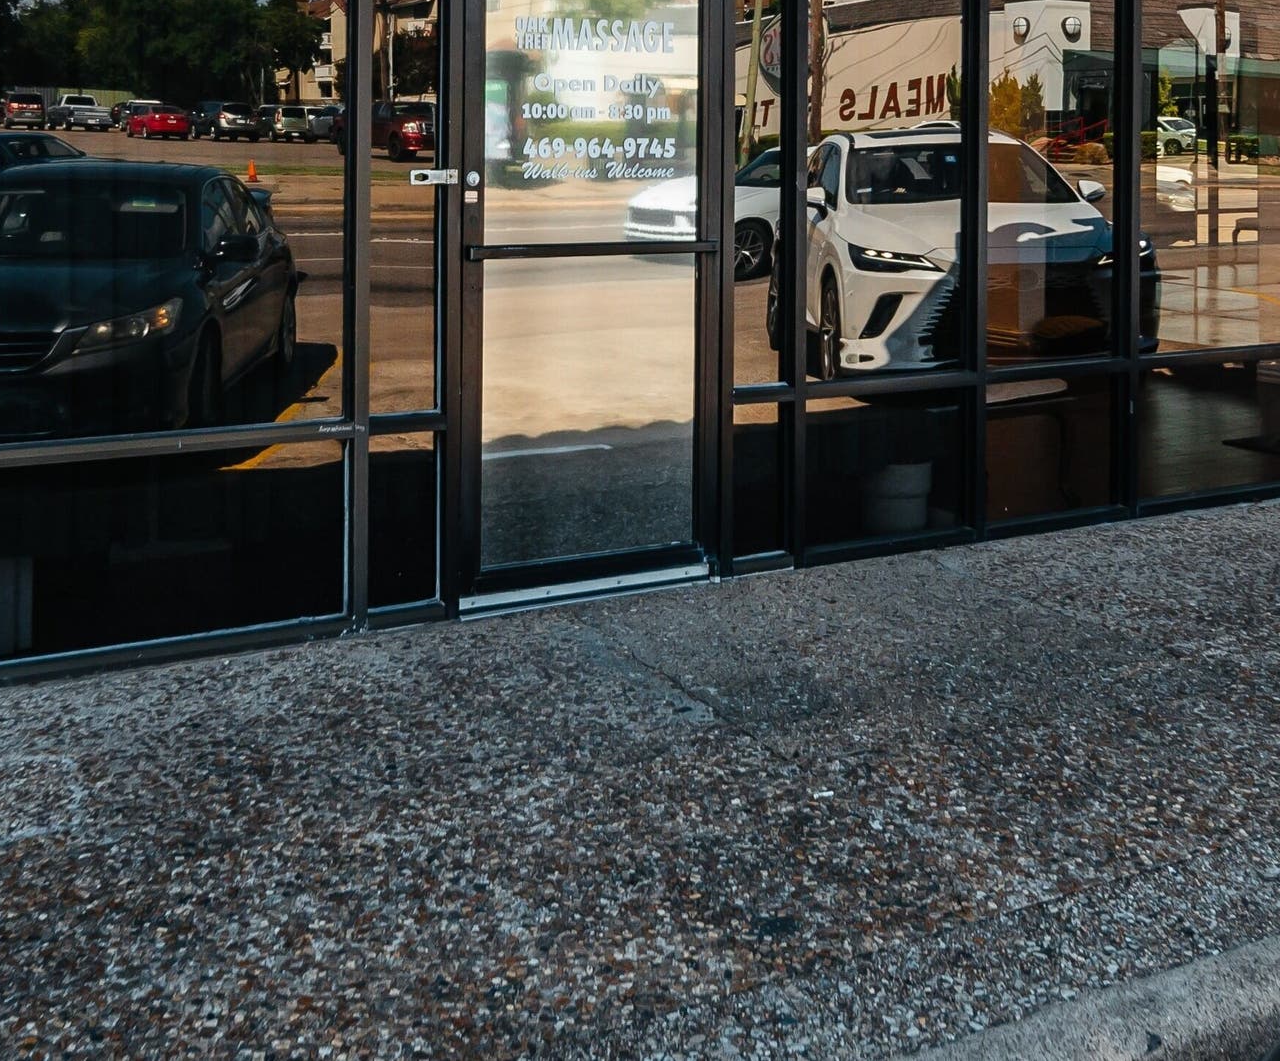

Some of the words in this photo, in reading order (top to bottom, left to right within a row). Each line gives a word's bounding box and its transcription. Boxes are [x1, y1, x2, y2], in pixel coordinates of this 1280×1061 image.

[515, 17, 548, 33] OAK
[551, 17, 674, 53] MASSAGE
[534, 73, 596, 97] Open
[604, 74, 660, 98] Daily
[522, 103, 567, 119] 10:00
[571, 106, 596, 119] am
[609, 104, 643, 119] 8:30
[646, 106, 670, 124] pm
[523, 138, 676, 159] 469-964-9745
[521, 161, 598, 179] Walk-ins
[605, 162, 674, 179] Welcome
